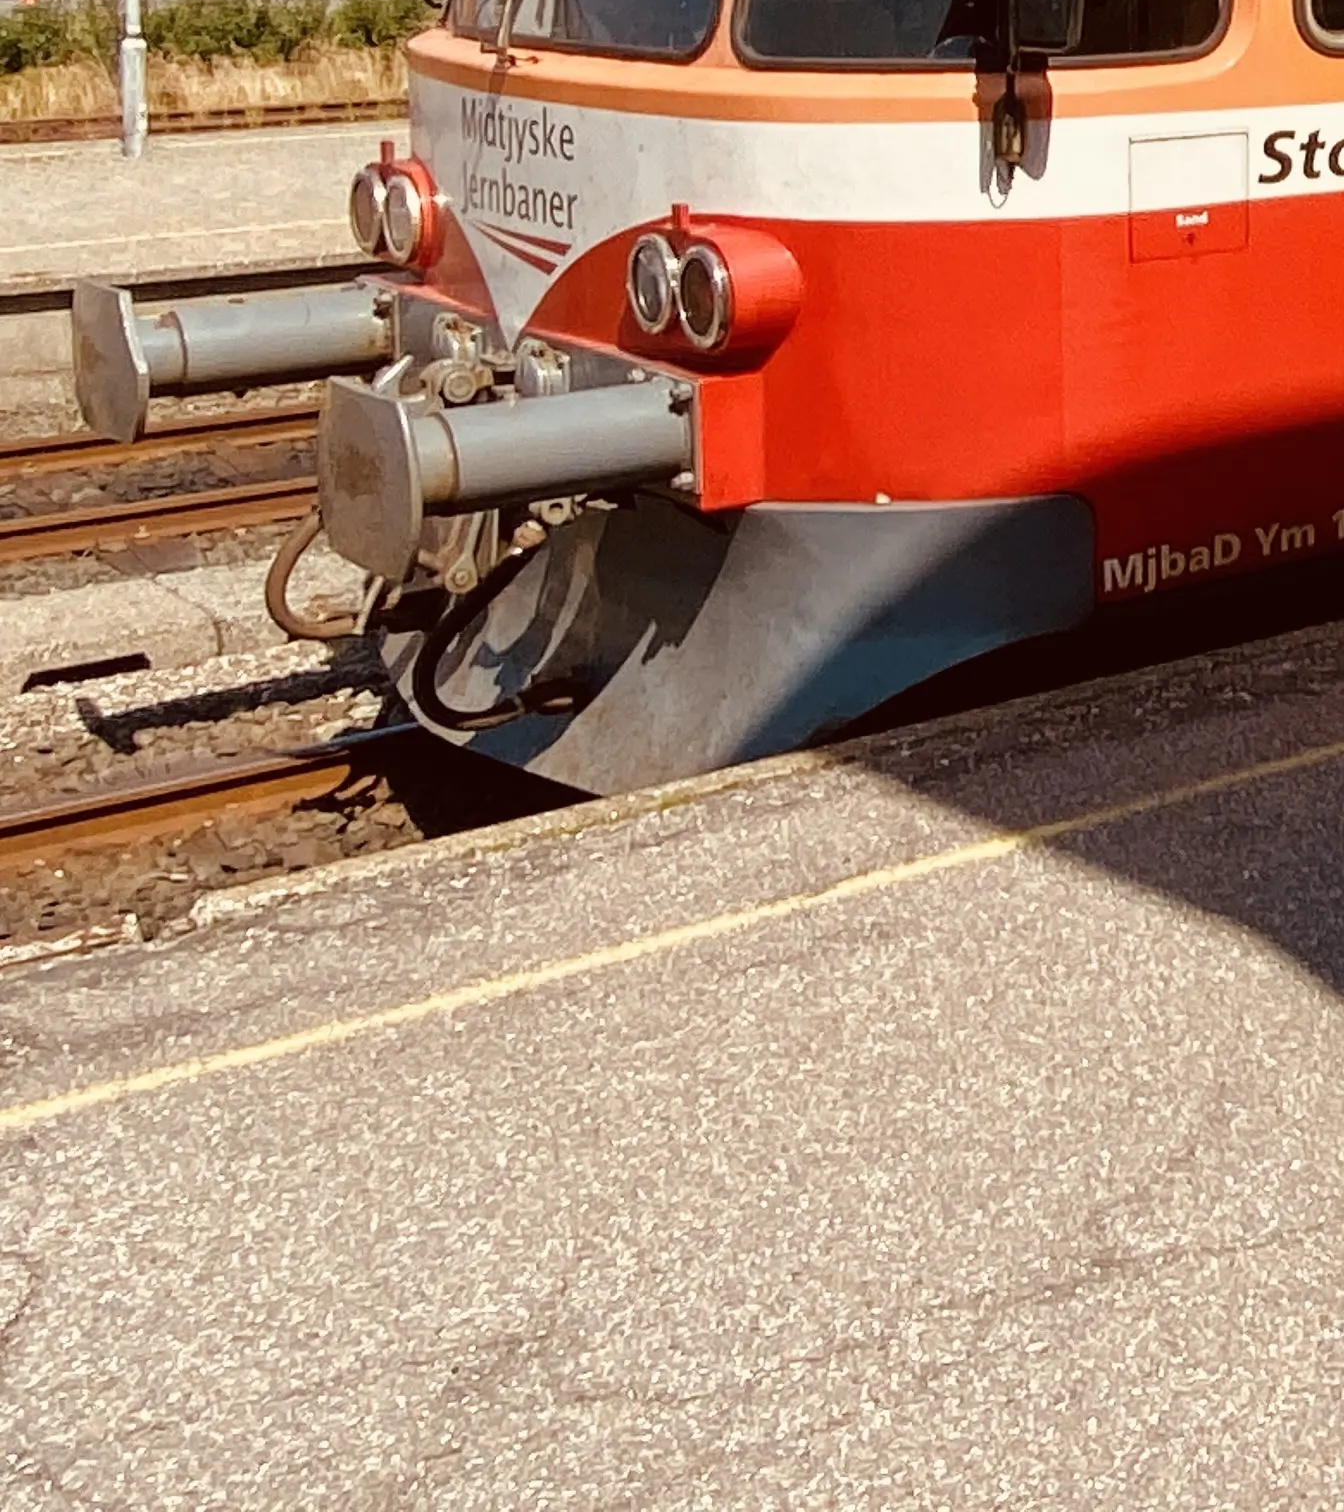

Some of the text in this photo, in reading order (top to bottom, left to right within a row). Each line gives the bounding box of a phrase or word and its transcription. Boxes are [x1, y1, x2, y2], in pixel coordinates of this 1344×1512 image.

[461, 97, 575, 164] Midtjyske
[460, 160, 578, 230] Jernbaner
[1103, 533, 1241, 593] MjbaD
[1254, 522, 1315, 556] Ym
